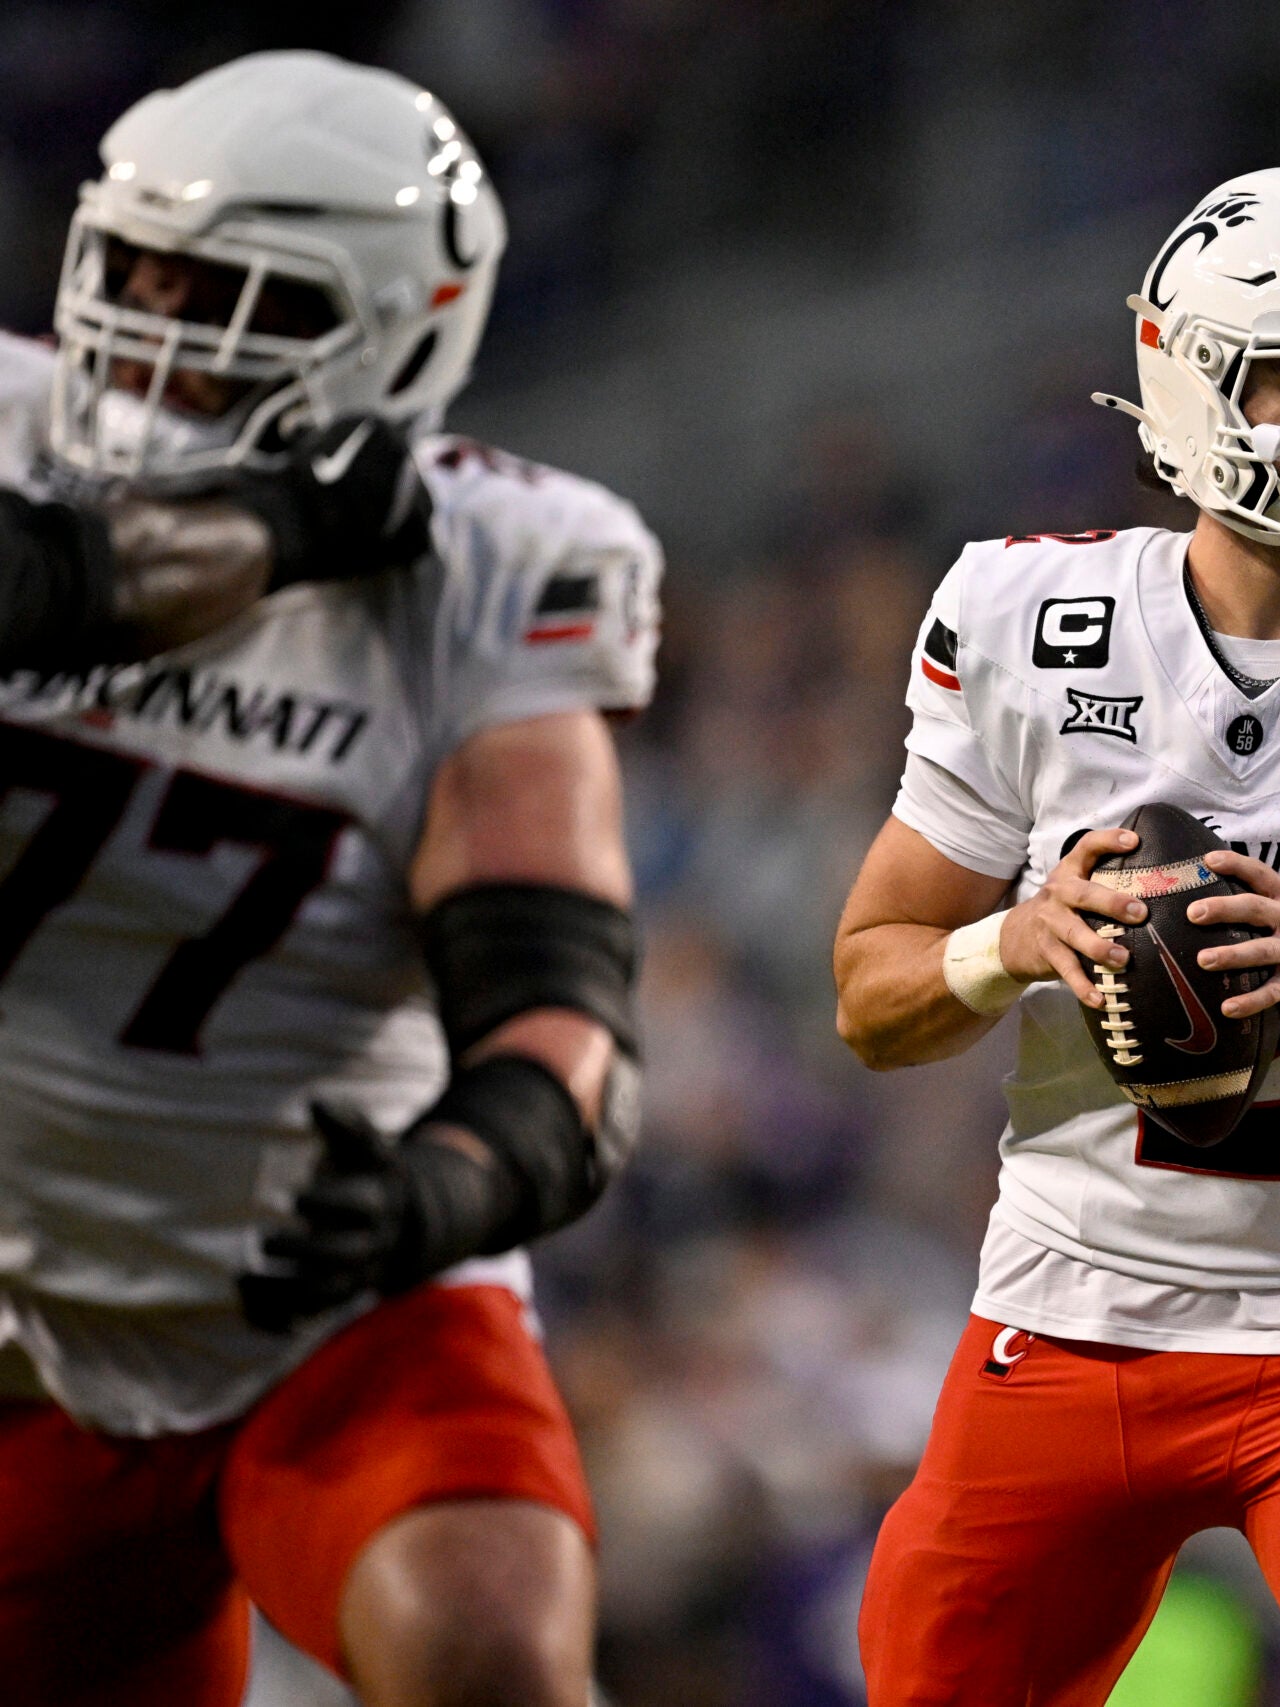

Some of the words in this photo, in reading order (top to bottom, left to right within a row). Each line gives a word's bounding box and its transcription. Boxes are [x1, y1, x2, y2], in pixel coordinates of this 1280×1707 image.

[1042, 601, 1106, 647] C
[1061, 689, 1142, 742] XII
[1238, 719, 1255, 735] JK
[1235, 735, 1254, 751] 58
[0, 718, 362, 1056] 77
